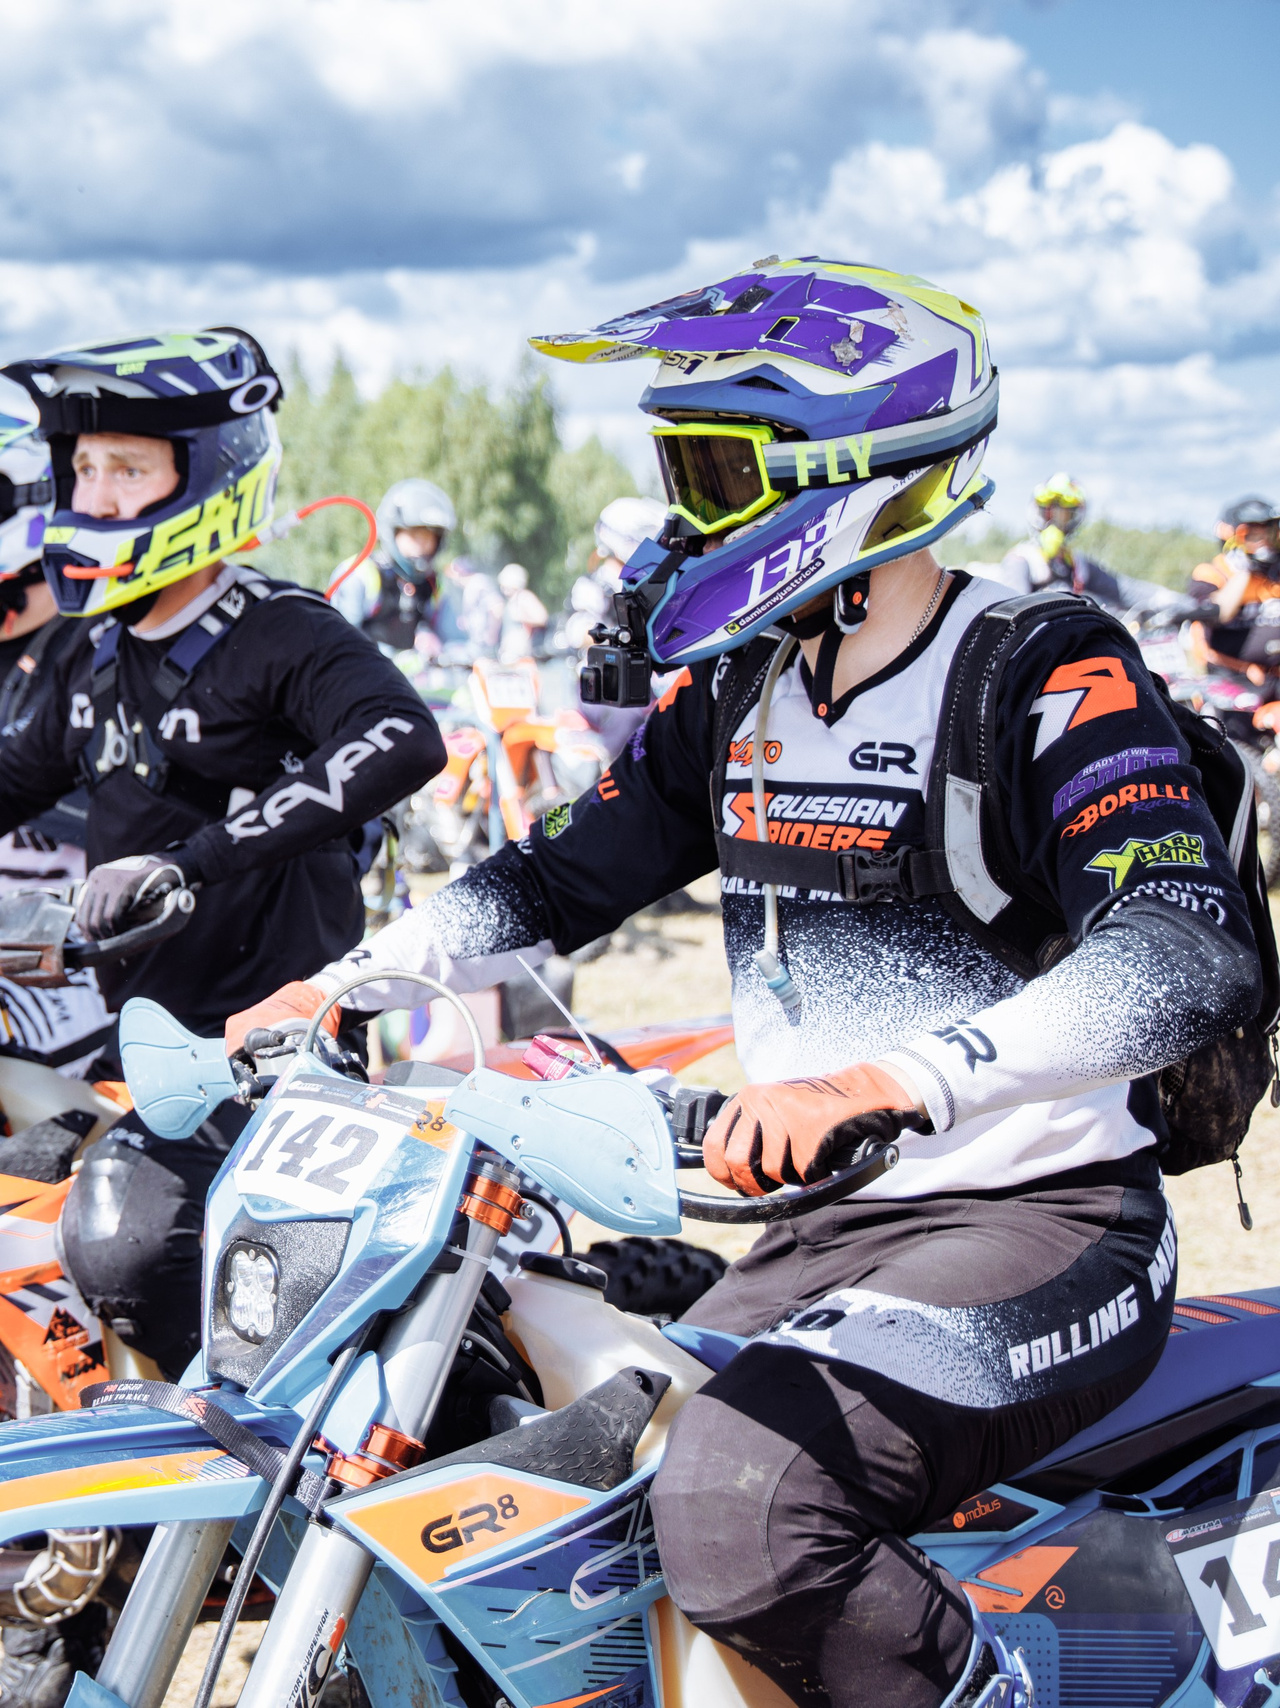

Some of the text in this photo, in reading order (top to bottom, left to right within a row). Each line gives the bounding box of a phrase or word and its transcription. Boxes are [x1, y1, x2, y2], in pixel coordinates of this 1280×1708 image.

[793, 434, 874, 486] FLY
[738, 559, 823, 627] damienwjusttricks
[848, 741, 919, 775] GR
[1082, 757, 1114, 776] READY
[1117, 749, 1129, 760] TO
[767, 793, 908, 828] RUSSIAN
[1060, 783, 1190, 839] BORILLI
[1130, 797, 1191, 815] Racing
[1140, 834, 1201, 862] HARD
[243, 1110, 379, 1195] 142
[1007, 1283, 1140, 1381] ROLLING
[125, 1393, 151, 1402] RACE
[420, 1493, 520, 1554] GR8
[965, 1498, 1001, 1523] mobius
[1180, 1518, 1222, 1536] MAXIMA
[302, 1608, 330, 1673] SUSPENSION
